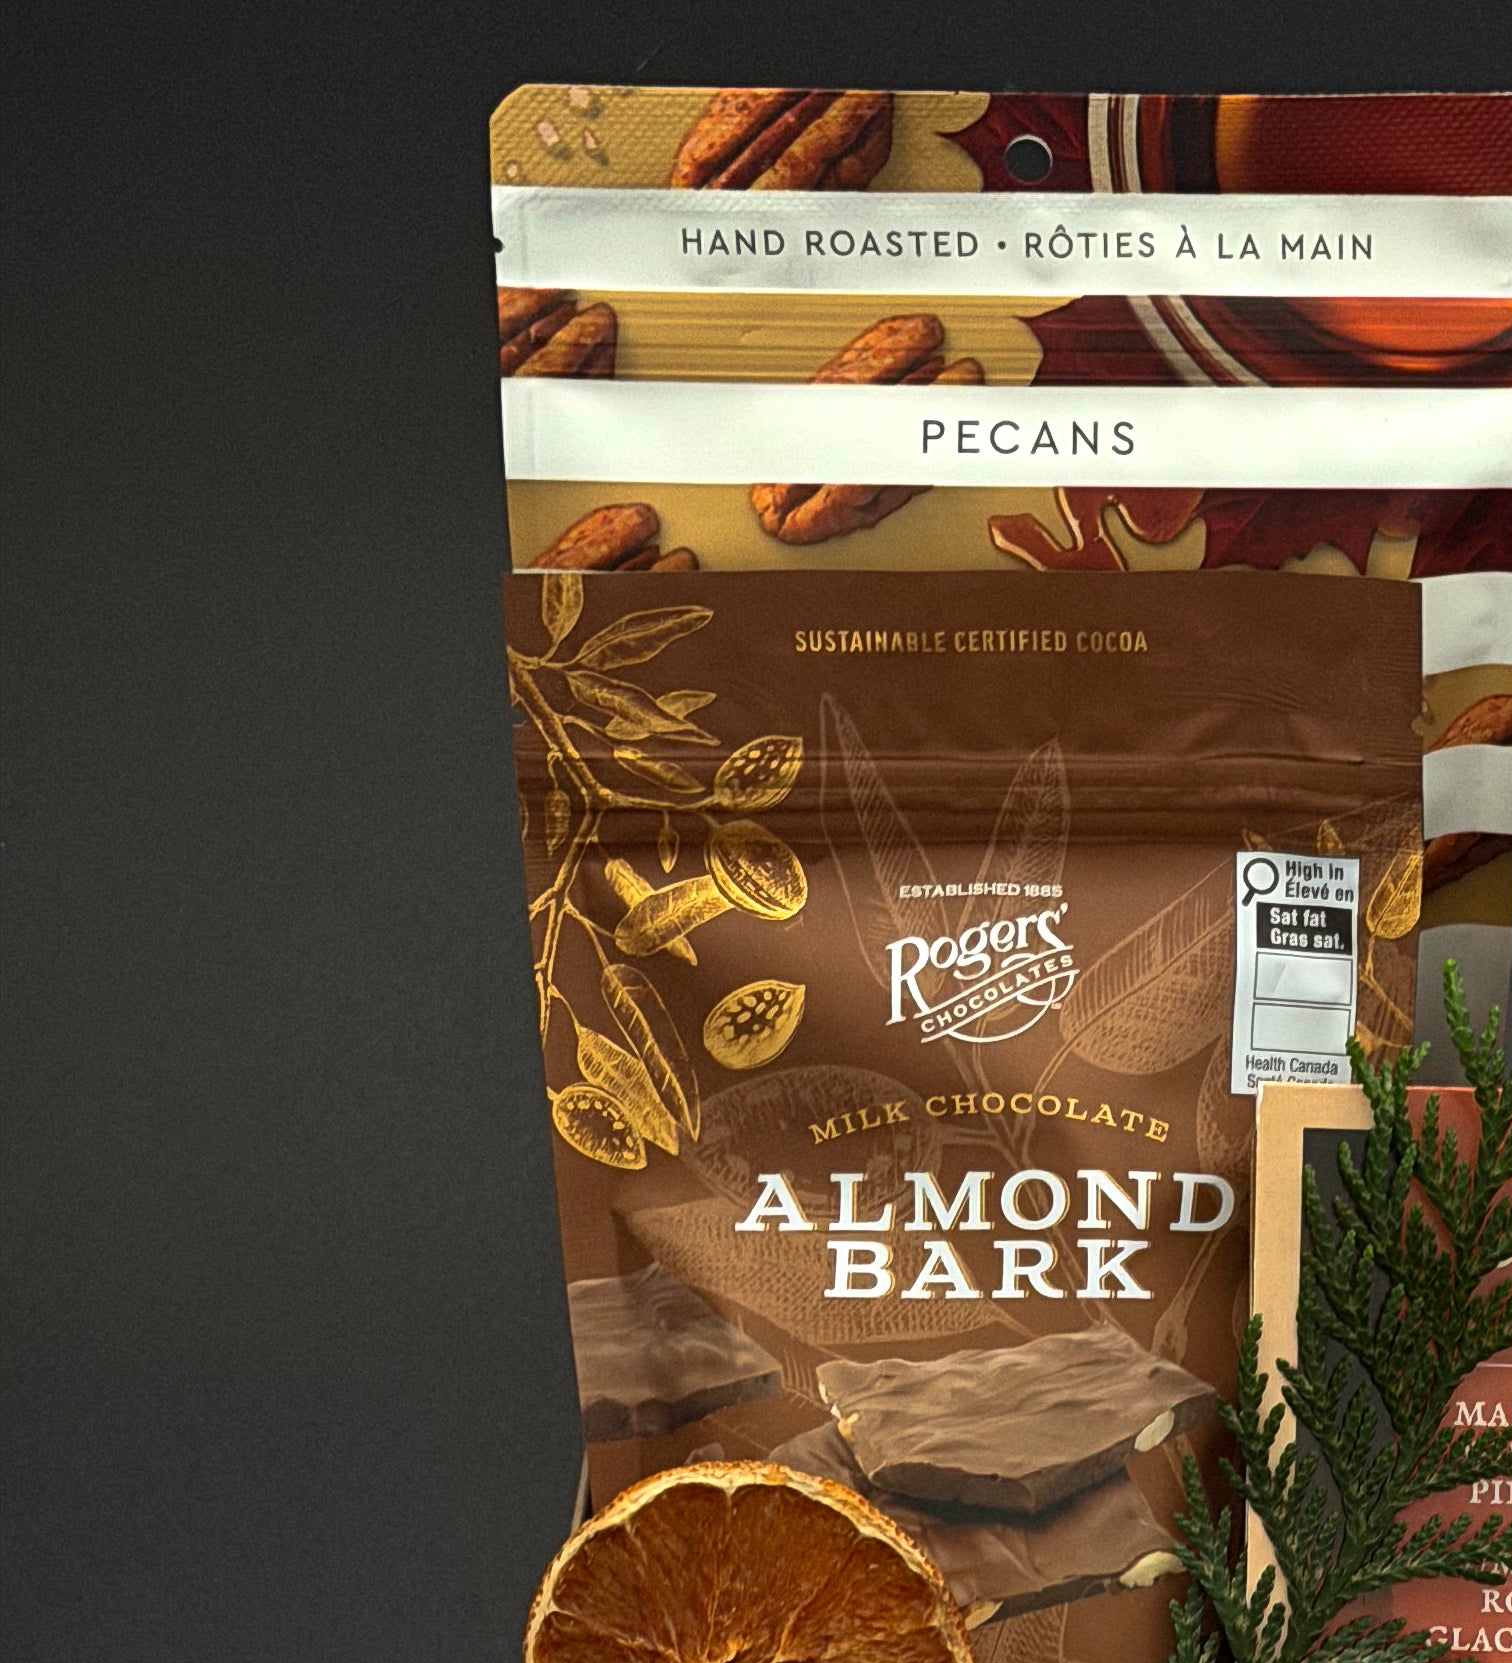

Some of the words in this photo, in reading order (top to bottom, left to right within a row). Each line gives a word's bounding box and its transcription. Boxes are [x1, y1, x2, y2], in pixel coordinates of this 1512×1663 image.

[682, 228, 785, 255] HAND
[806, 230, 978, 257] ROASTED
[1025, 224, 1155, 259] RÔTIES
[1176, 225, 1197, 259] À
[1218, 233, 1260, 259] LA
[1282, 233, 1372, 260] MAIN
[923, 420, 1135, 455] PECANS
[795, 630, 946, 652] SUSTAINABLE
[954, 630, 1067, 652] CERTIFIED
[1076, 631, 1148, 652] COCOA
[1285, 860, 1323, 881] High
[899, 882, 1020, 898] ESTABLISHED
[1285, 878, 1330, 900] Élevé
[1335, 888, 1354, 903] en
[1270, 907, 1298, 926] Sat
[1303, 908, 1327, 928] fat
[1270, 927, 1309, 948] Gras
[1313, 933, 1345, 950] sat.
[921, 955, 1074, 1033] CHOCOLATES
[1246, 1055, 1286, 1072] Health
[1290, 1058, 1338, 1075] Canada
[807, 1101, 909, 1145] MILK
[925, 1092, 1170, 1143] CHOCOLATE
[735, 1169, 1235, 1233] ALMOND
[823, 1238, 1154, 1300] BARK
